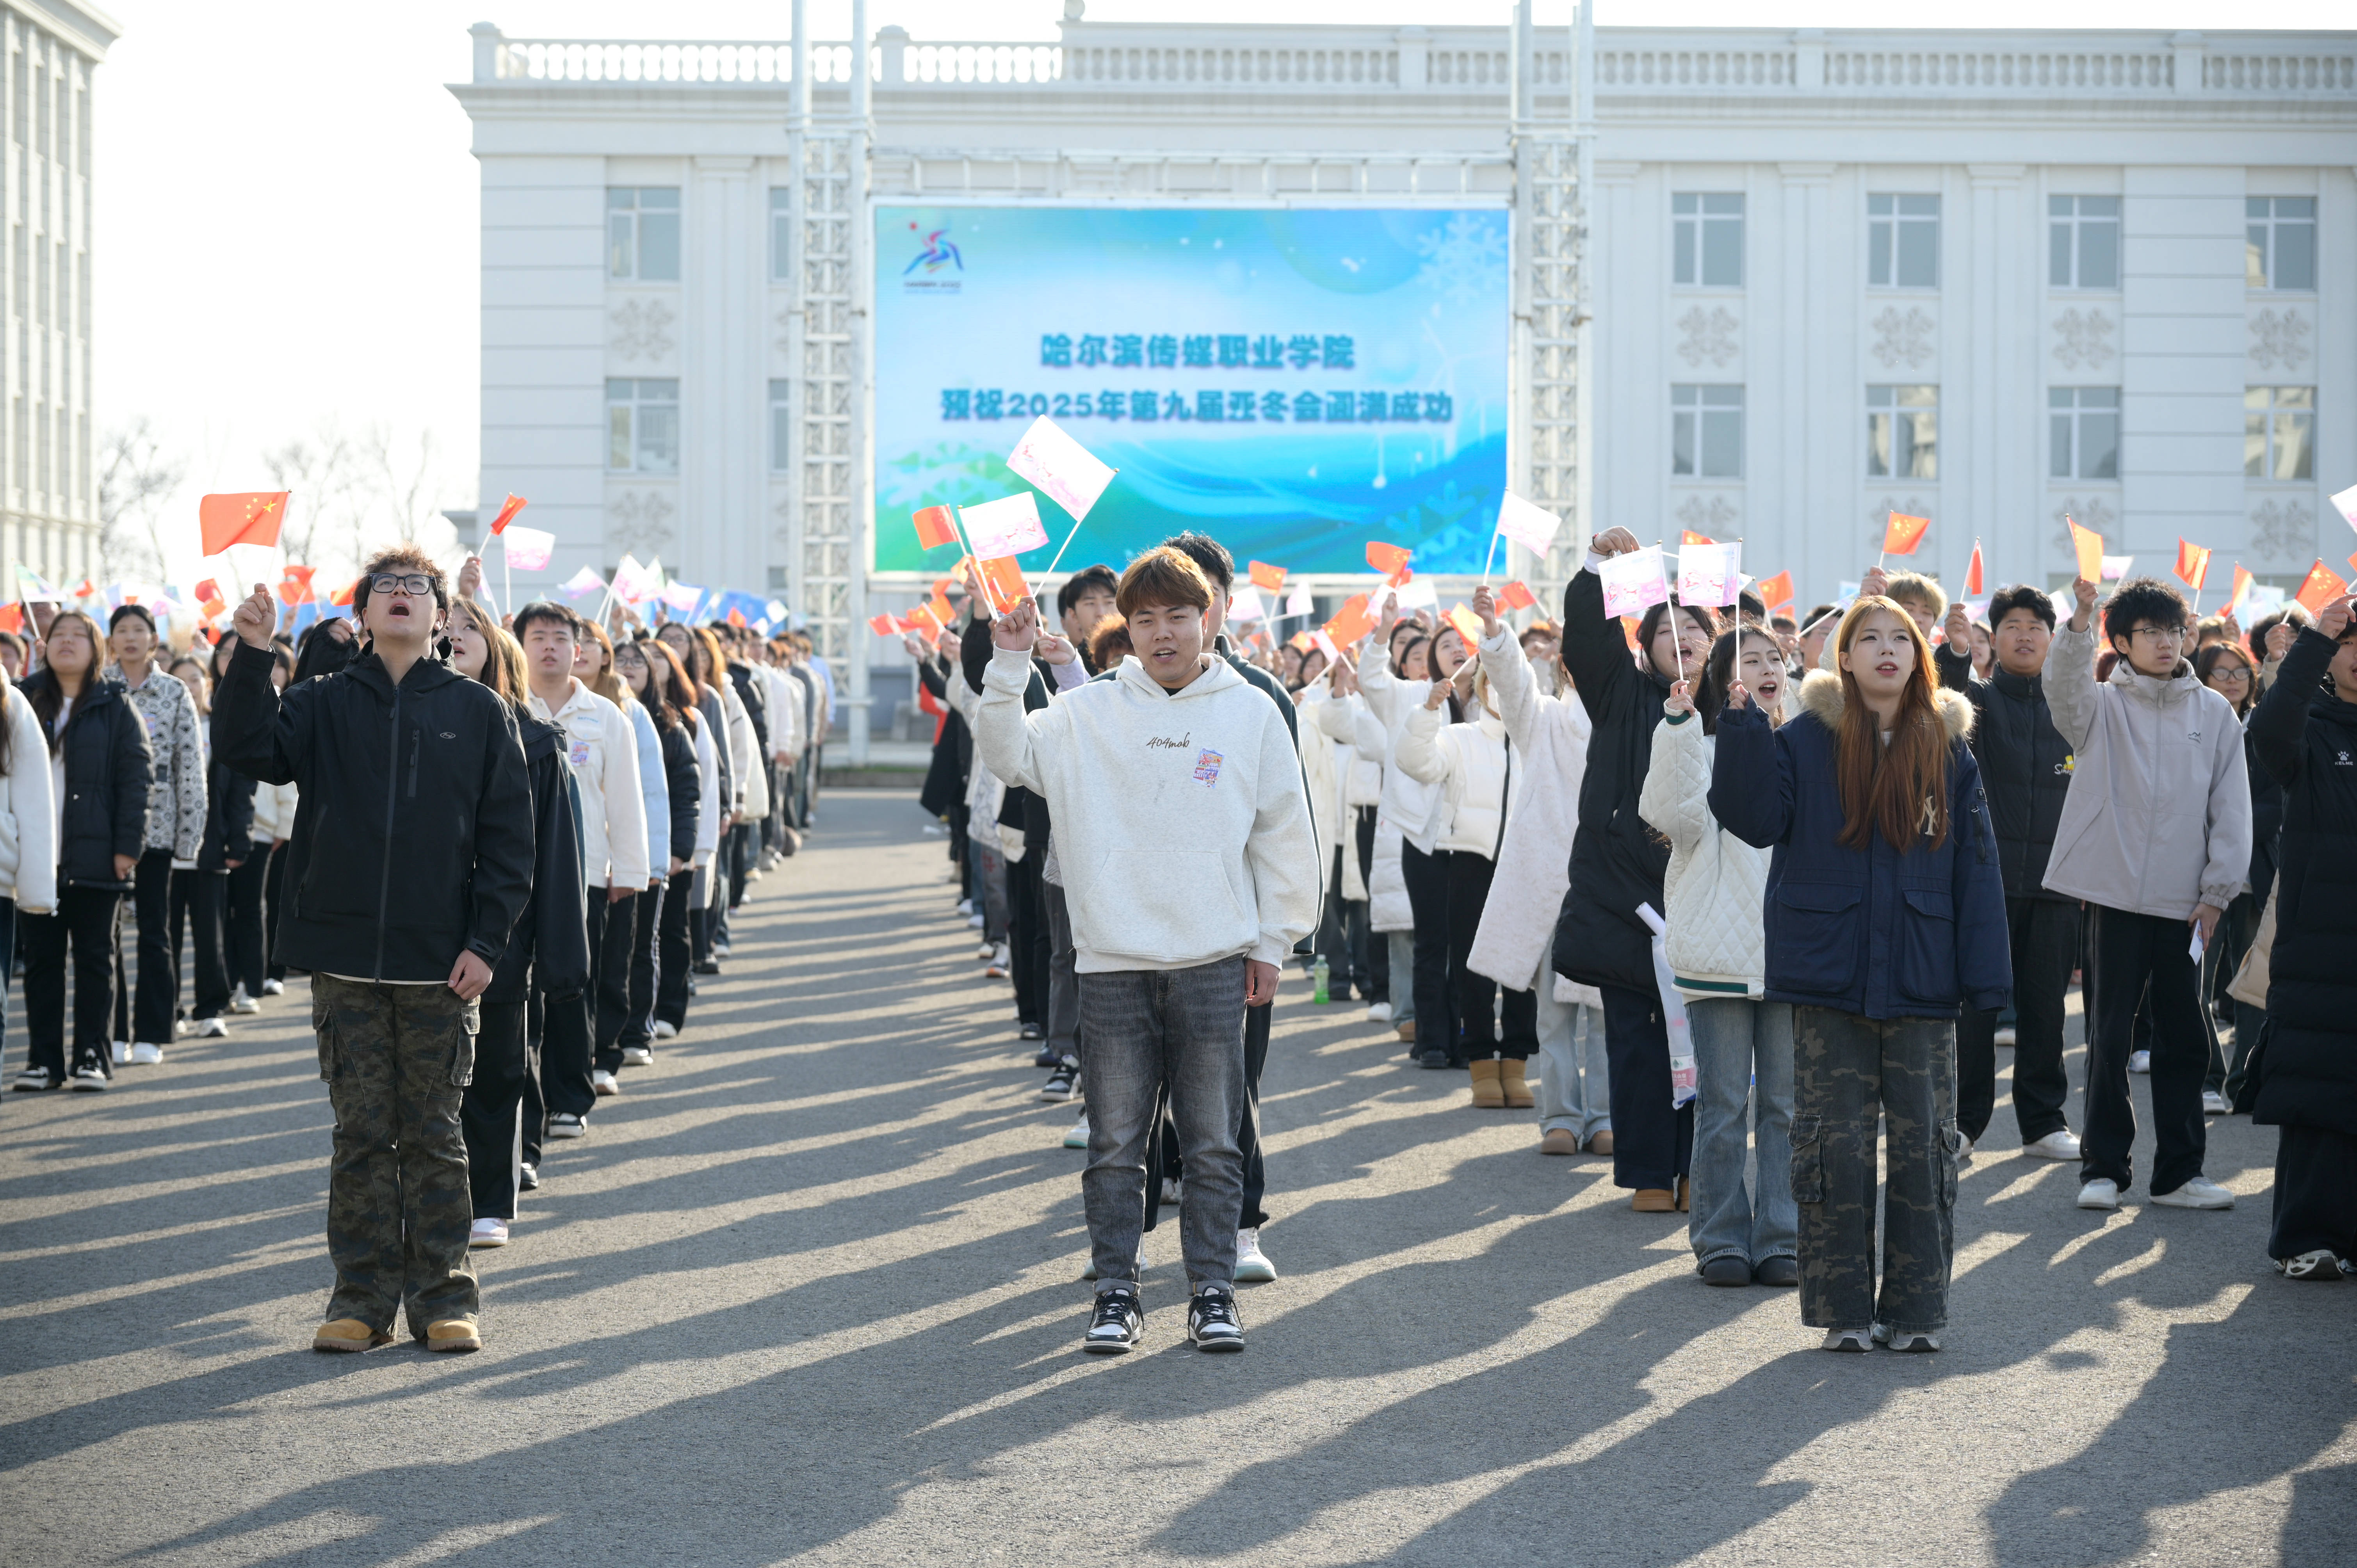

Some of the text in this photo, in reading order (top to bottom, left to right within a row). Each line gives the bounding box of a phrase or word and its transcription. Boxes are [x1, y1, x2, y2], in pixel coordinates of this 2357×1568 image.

[1041, 334, 1355, 368] 哈尔滨传媒职业学院
[1146, 731, 1190, 749] 404mob
